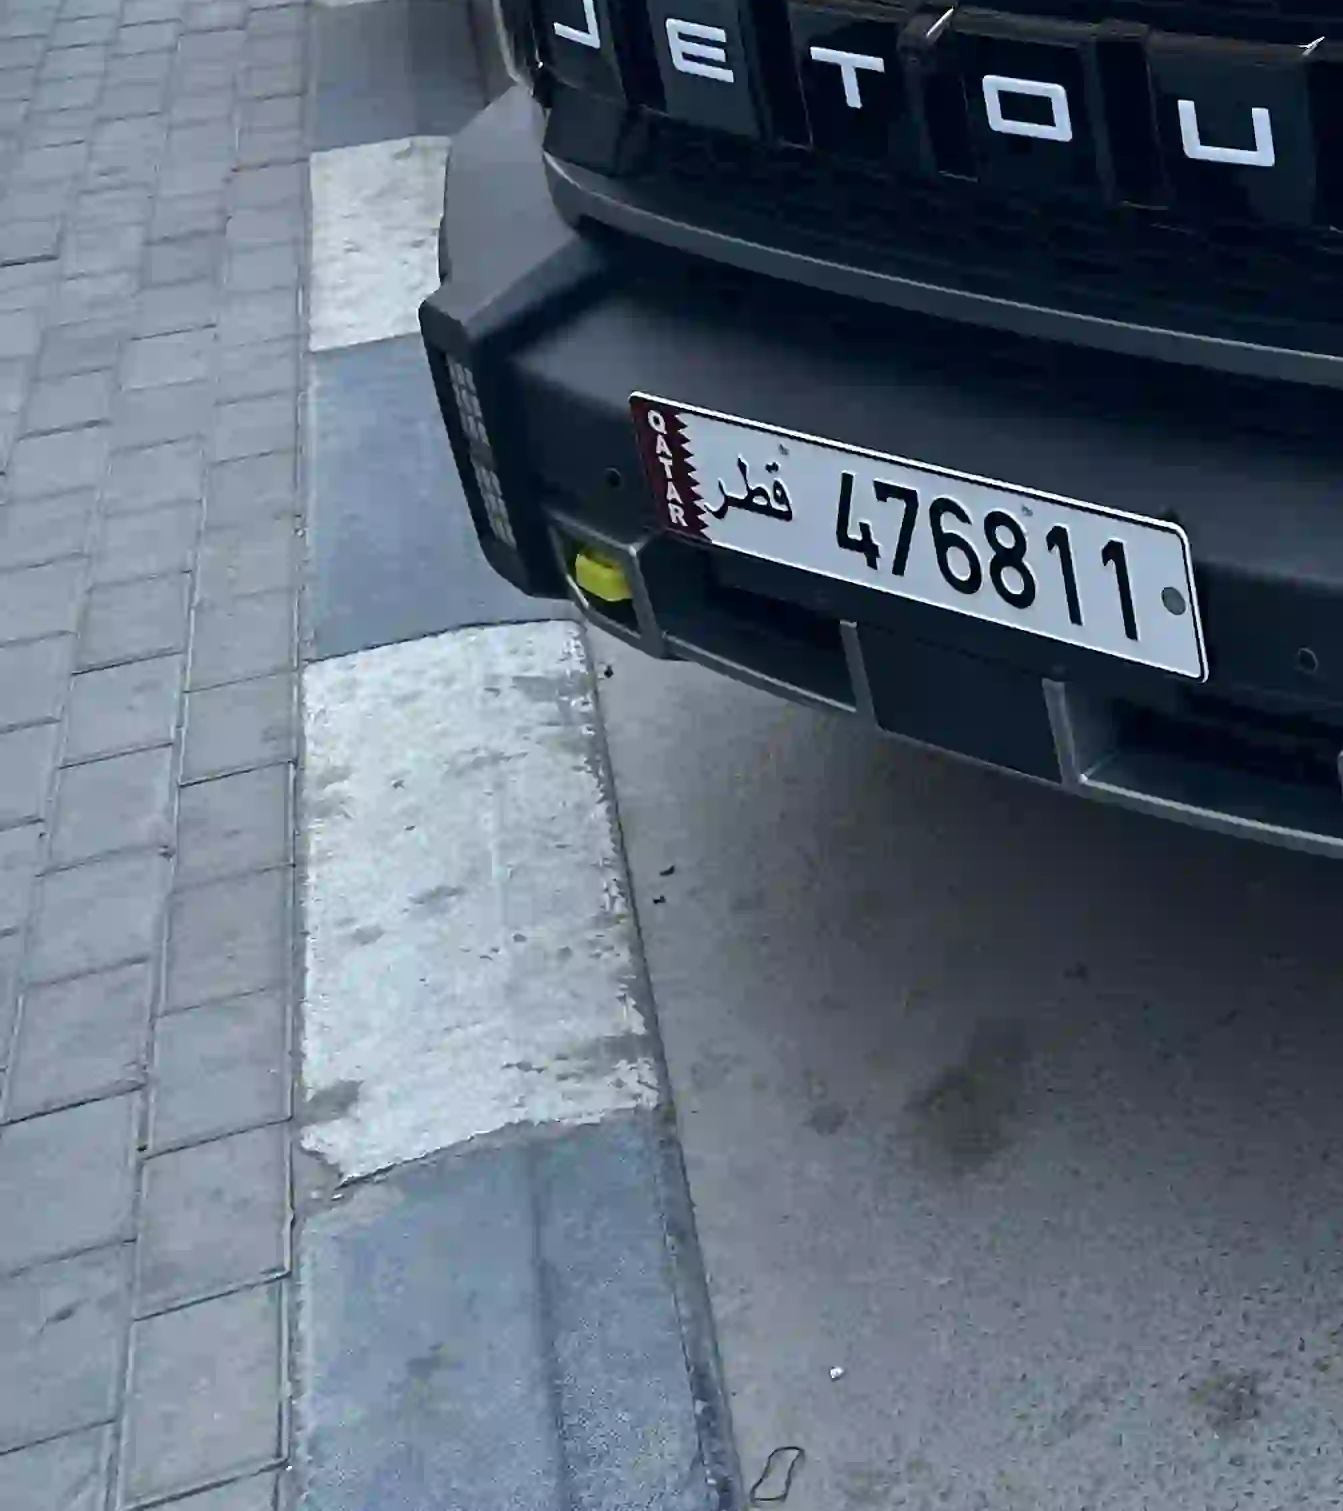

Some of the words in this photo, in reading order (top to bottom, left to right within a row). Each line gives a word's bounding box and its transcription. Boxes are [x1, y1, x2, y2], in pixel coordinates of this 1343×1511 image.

[648, 410, 688, 526] QATAR
[703, 454, 793, 522] قطر
[836, 470, 1138, 640] 476811
